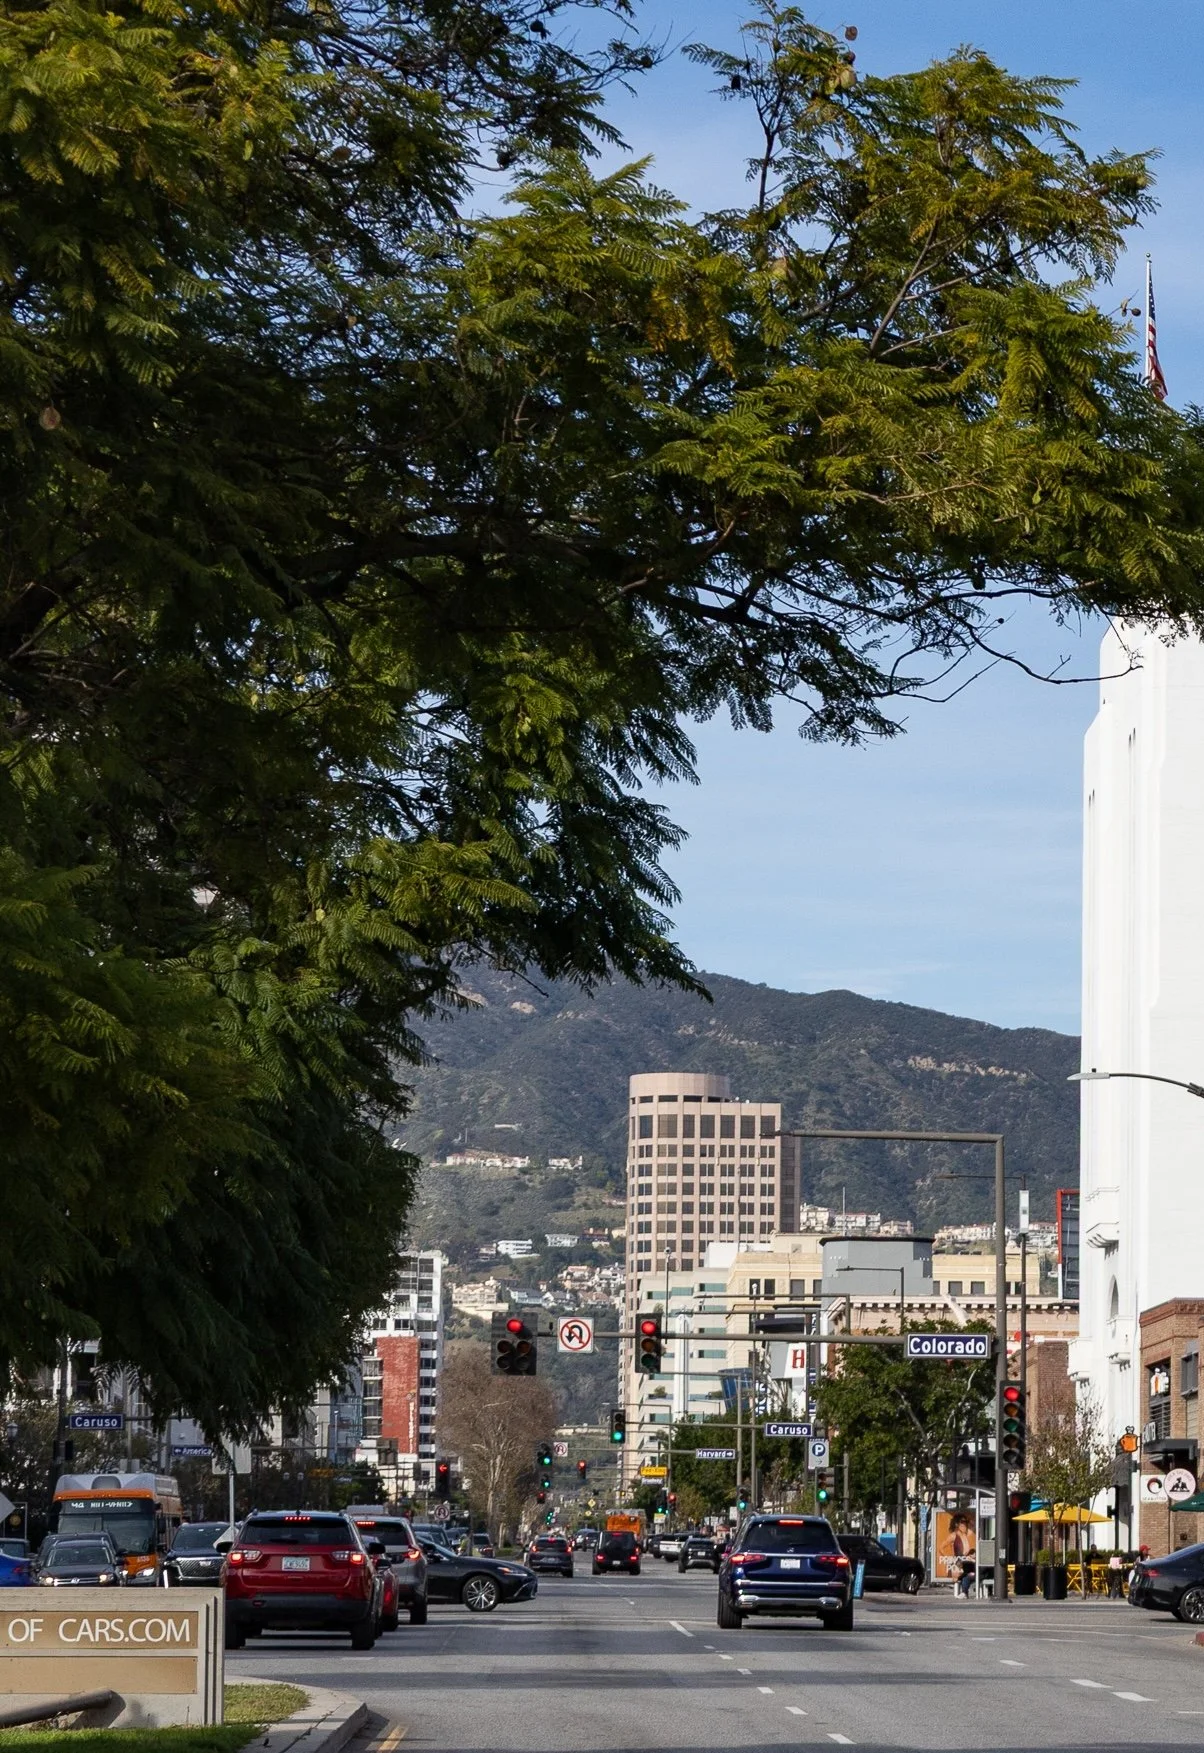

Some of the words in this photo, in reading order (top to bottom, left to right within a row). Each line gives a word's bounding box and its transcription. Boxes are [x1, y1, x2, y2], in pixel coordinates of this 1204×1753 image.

[910, 1338, 986, 1354] Colorado
[75, 1417, 118, 1427] Caruso
[770, 1424, 808, 1435] Caruso
[697, 1450, 727, 1458] Harvard
[8, 1618, 44, 1642] OF
[58, 1618, 191, 1642] CARS.COM
